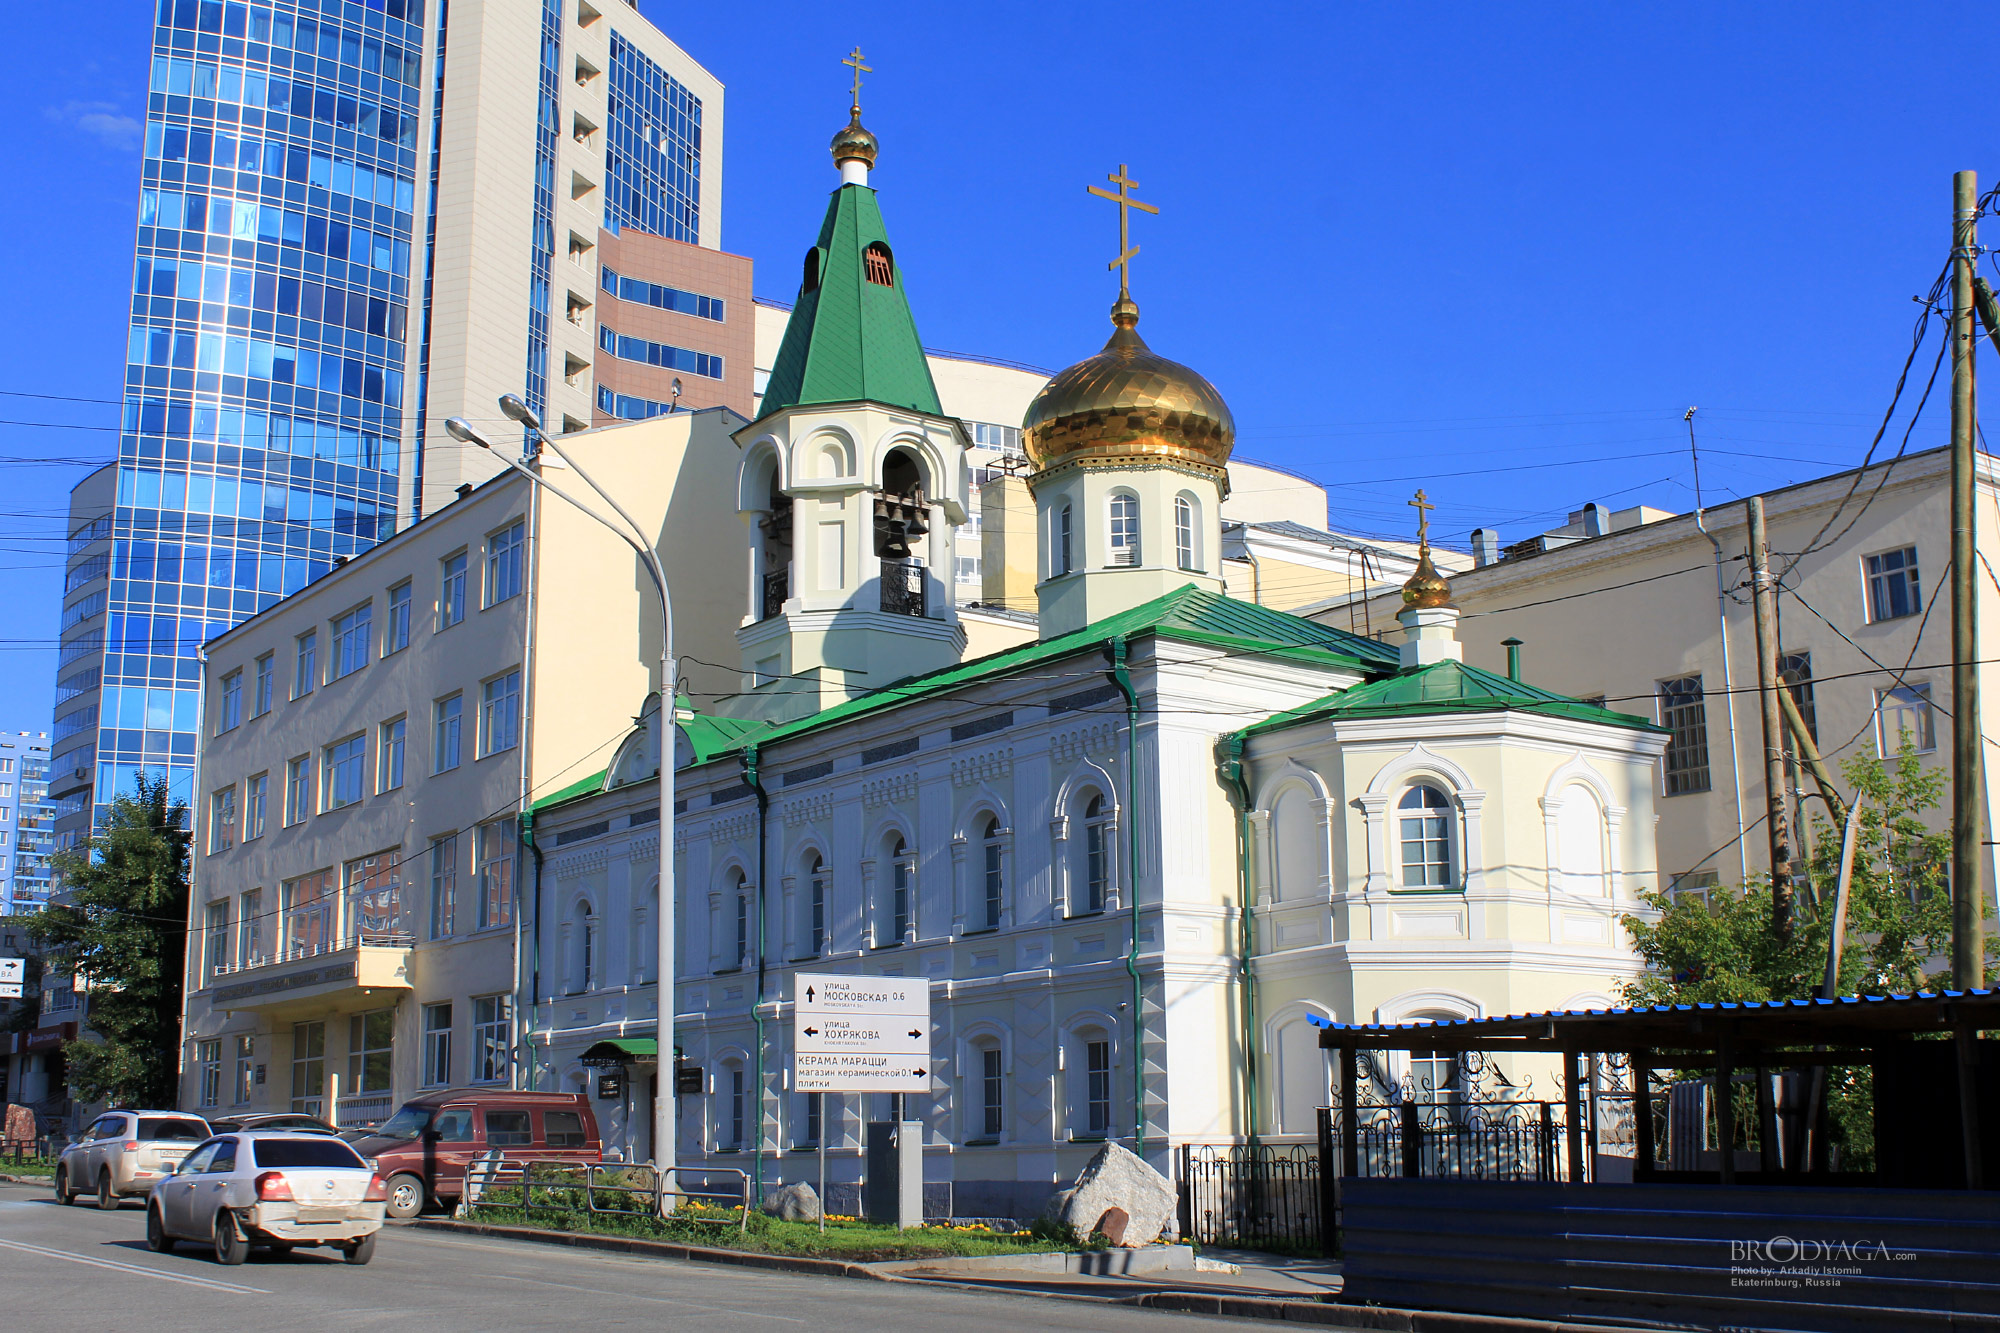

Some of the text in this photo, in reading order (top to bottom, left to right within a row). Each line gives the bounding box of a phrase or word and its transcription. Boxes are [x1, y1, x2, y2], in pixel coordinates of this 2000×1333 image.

[824, 992, 905, 1002] МОСКОВСКАЯ 0.6
[824, 1030, 880, 1040] ХОХРЯКОВА
[798, 1056, 887, 1067] КЕРАМА МАРАЦЦИ
[838, 1068, 901, 1078] керамической
[902, 1069, 912, 1077] 0.1
